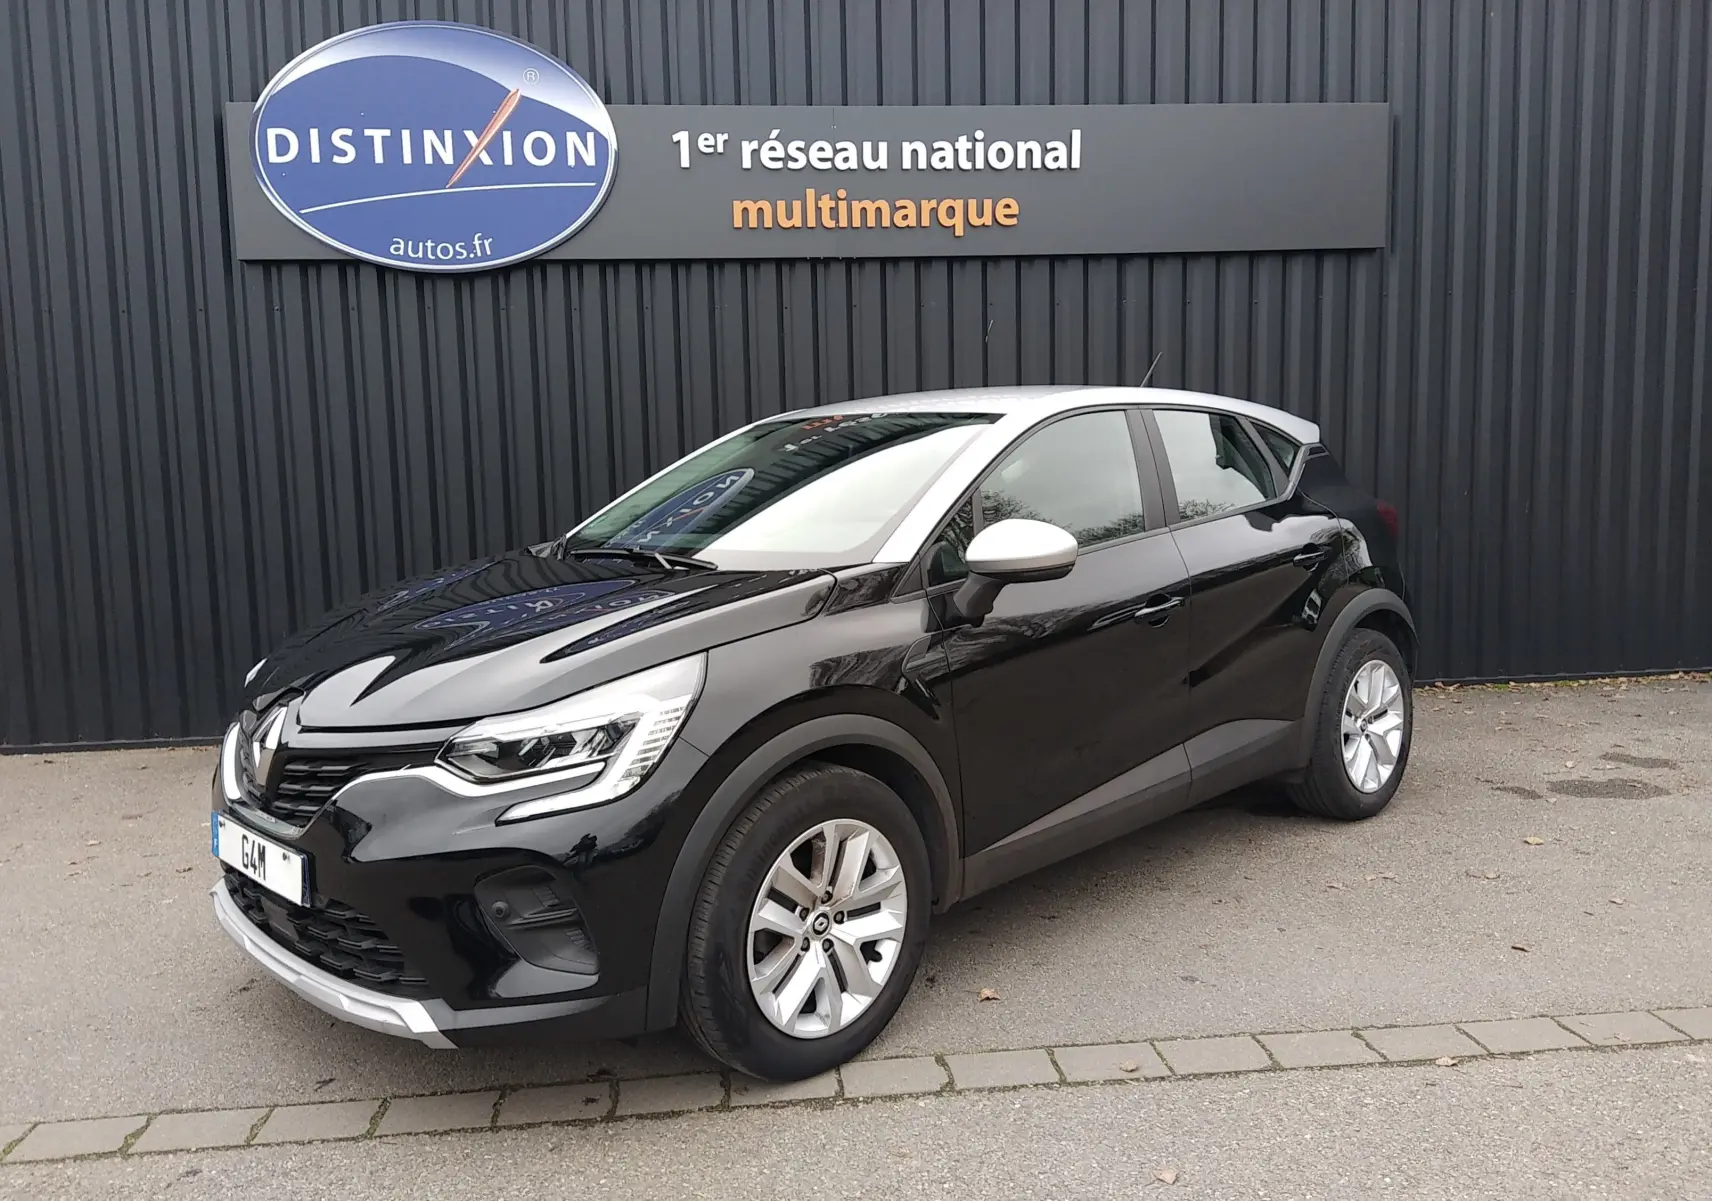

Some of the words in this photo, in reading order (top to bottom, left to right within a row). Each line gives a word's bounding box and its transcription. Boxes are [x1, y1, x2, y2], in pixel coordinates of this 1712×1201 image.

[266, 127, 597, 167] DISTINXION
[672, 130, 729, 169] 1er
[740, 129, 888, 171] réseau
[901, 128, 1082, 170] national
[732, 188, 1020, 237] multimarque
[389, 232, 494, 261] autos.fr
[241, 834, 266, 881] G4M
